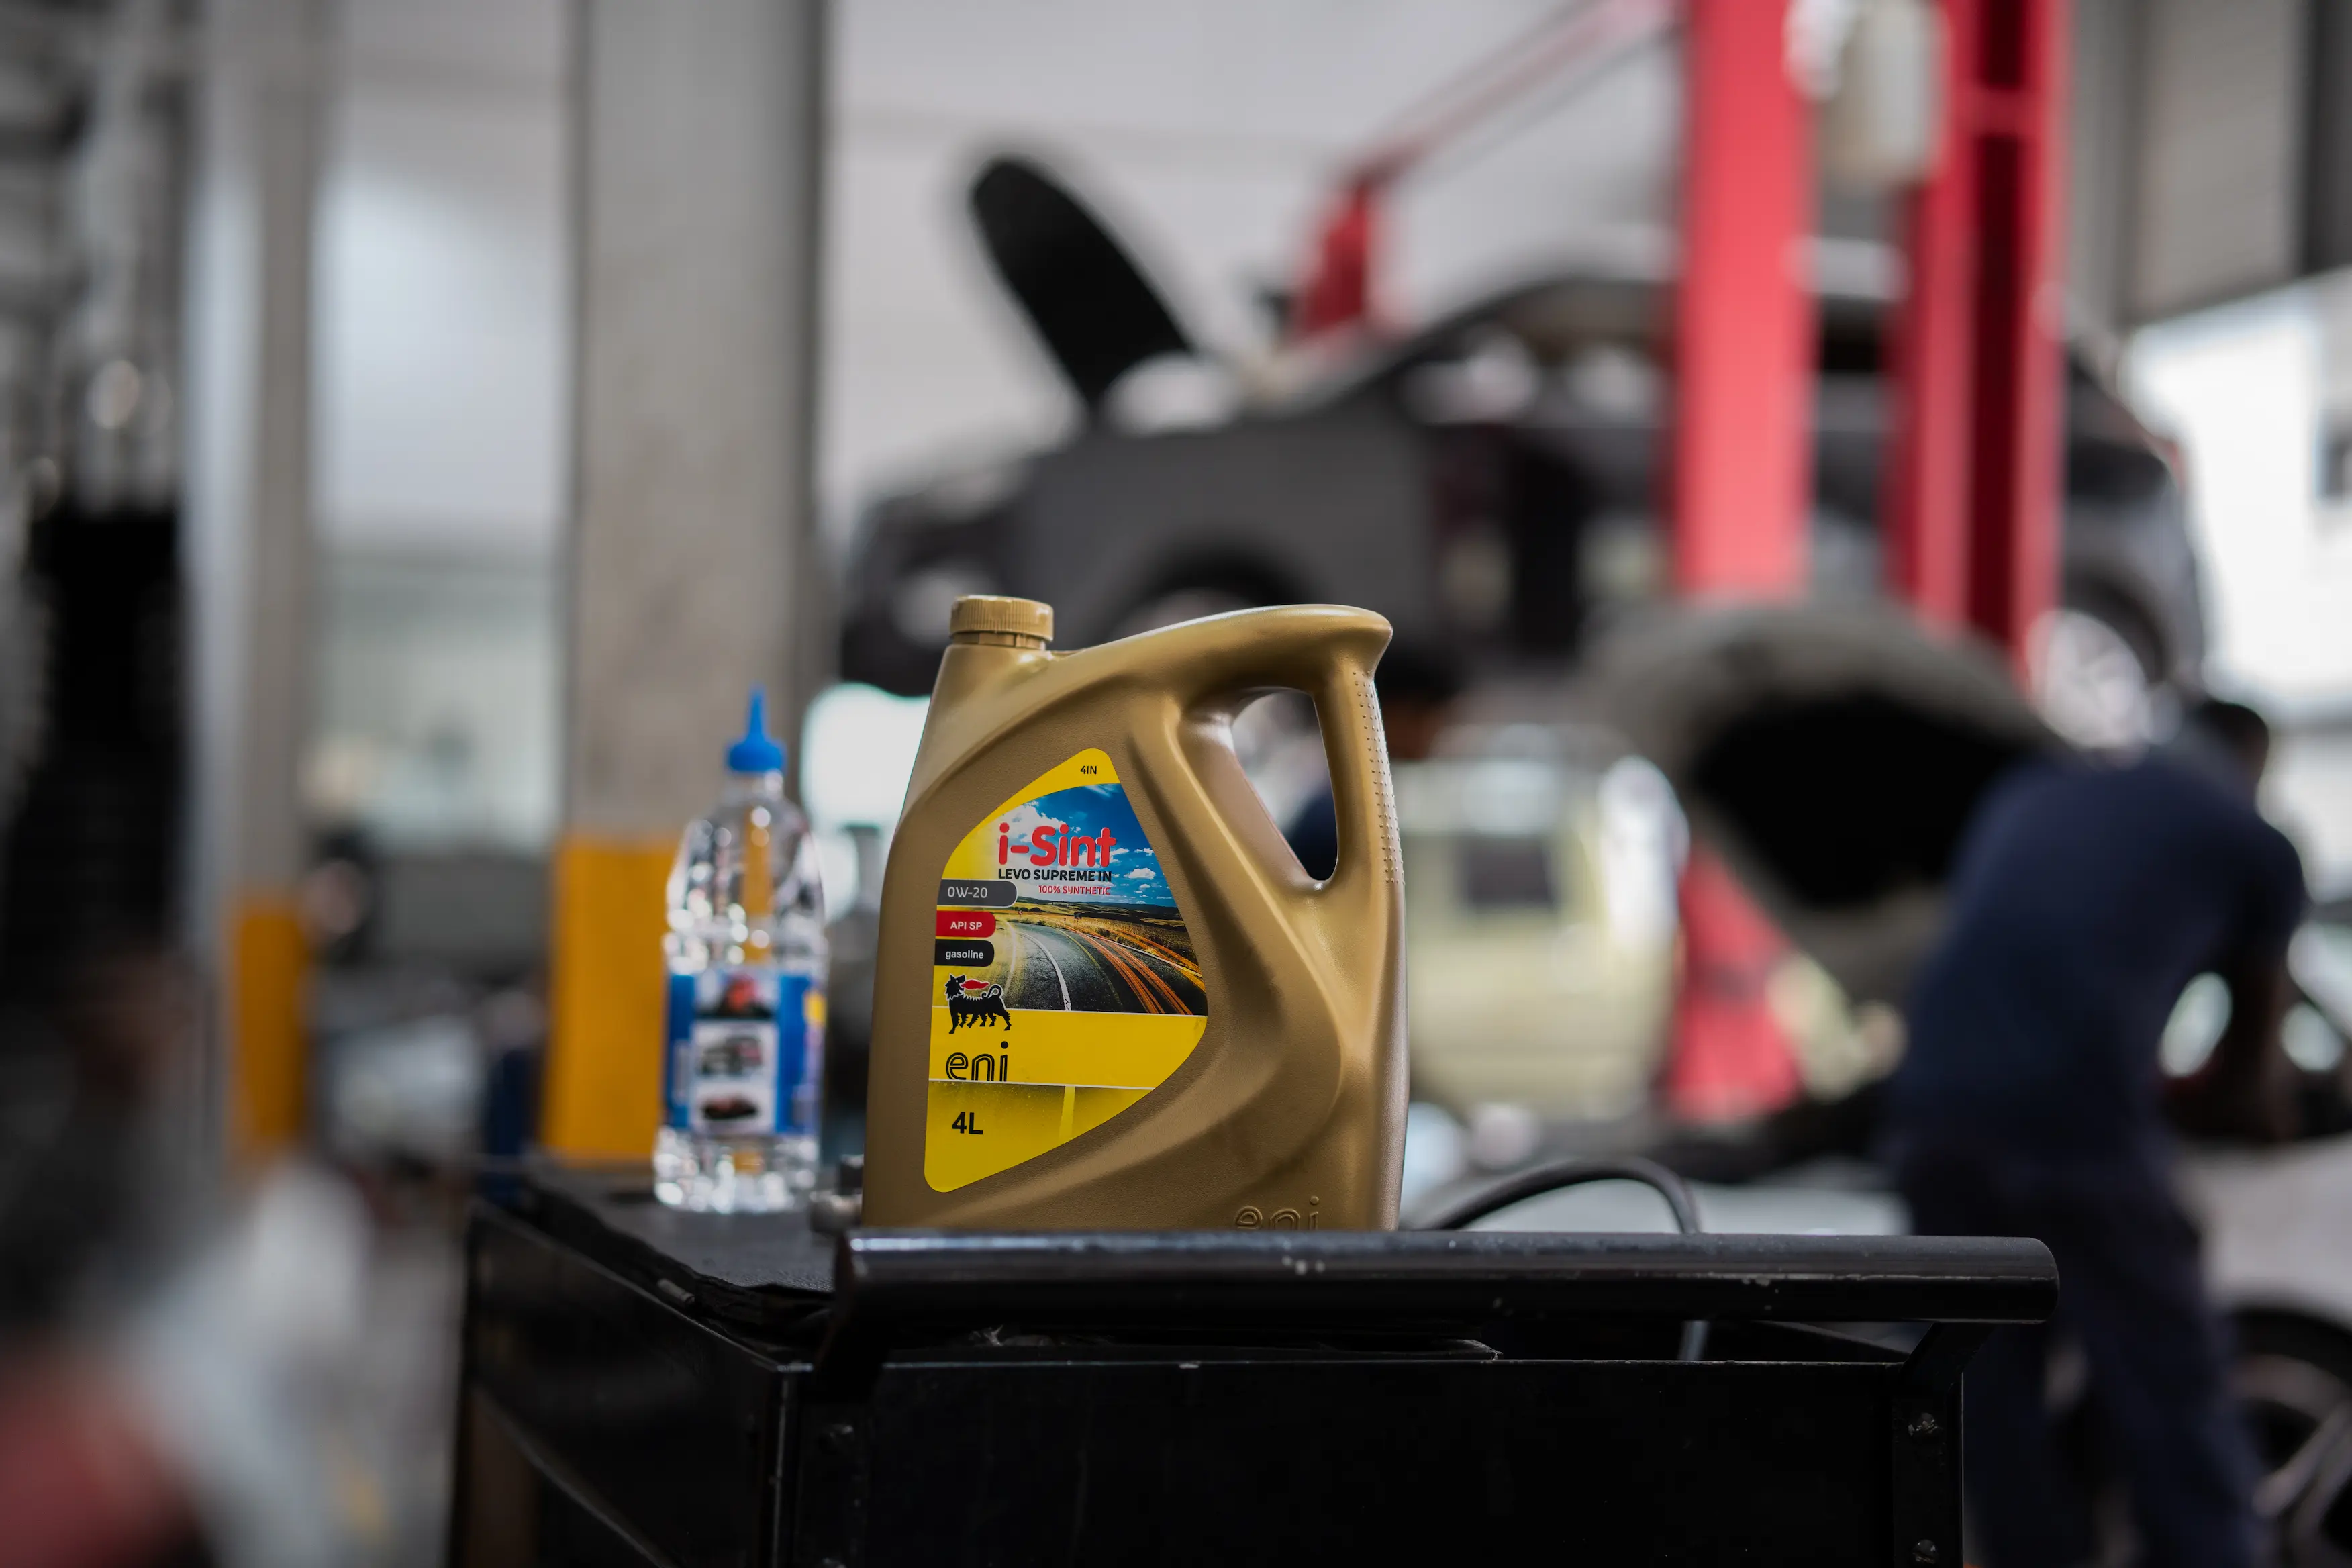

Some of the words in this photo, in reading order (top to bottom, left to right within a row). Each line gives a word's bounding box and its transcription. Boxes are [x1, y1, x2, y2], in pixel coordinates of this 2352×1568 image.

[1080, 765, 1097, 775] 4IN
[998, 822, 1117, 867] i-Sint
[998, 868, 1031, 880] LEVO
[1033, 869, 1095, 881] SUPREME
[1097, 871, 1112, 881] IN
[947, 887, 988, 899] 0W-20
[1038, 885, 1061, 893] 100%
[1063, 885, 1112, 895] SYNTHETIC
[950, 921, 967, 930] API
[969, 922, 983, 930] SP
[946, 950, 983, 959] gasoline
[946, 1042, 1008, 1081] eni
[952, 1112, 983, 1135] 4L
